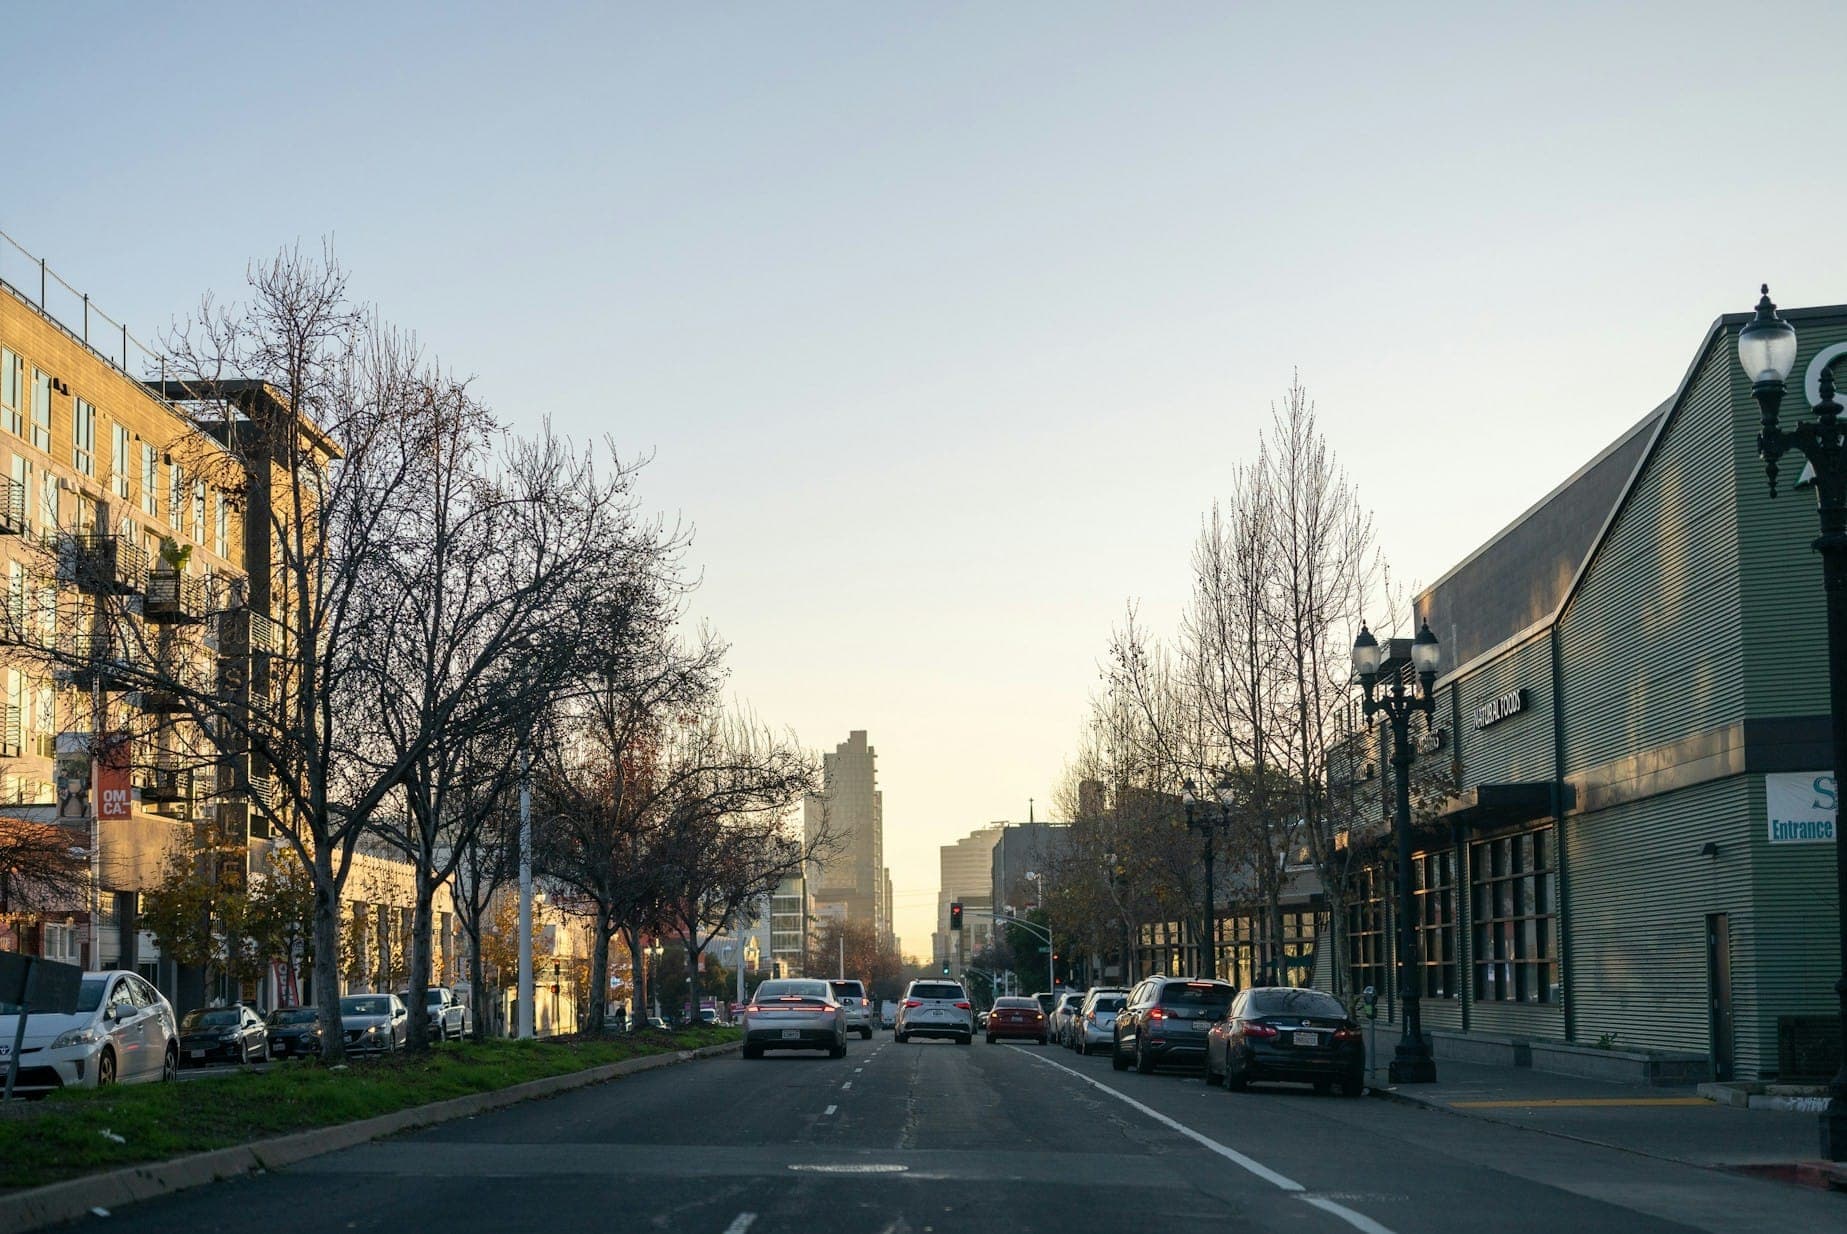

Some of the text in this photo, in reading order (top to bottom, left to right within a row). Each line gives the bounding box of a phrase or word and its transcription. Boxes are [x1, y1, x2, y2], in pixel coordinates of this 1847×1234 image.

[1473, 688, 1521, 730] NATURAL FOODS
[103, 789, 127, 802] OM
[1773, 819, 1833, 841] Entrance
